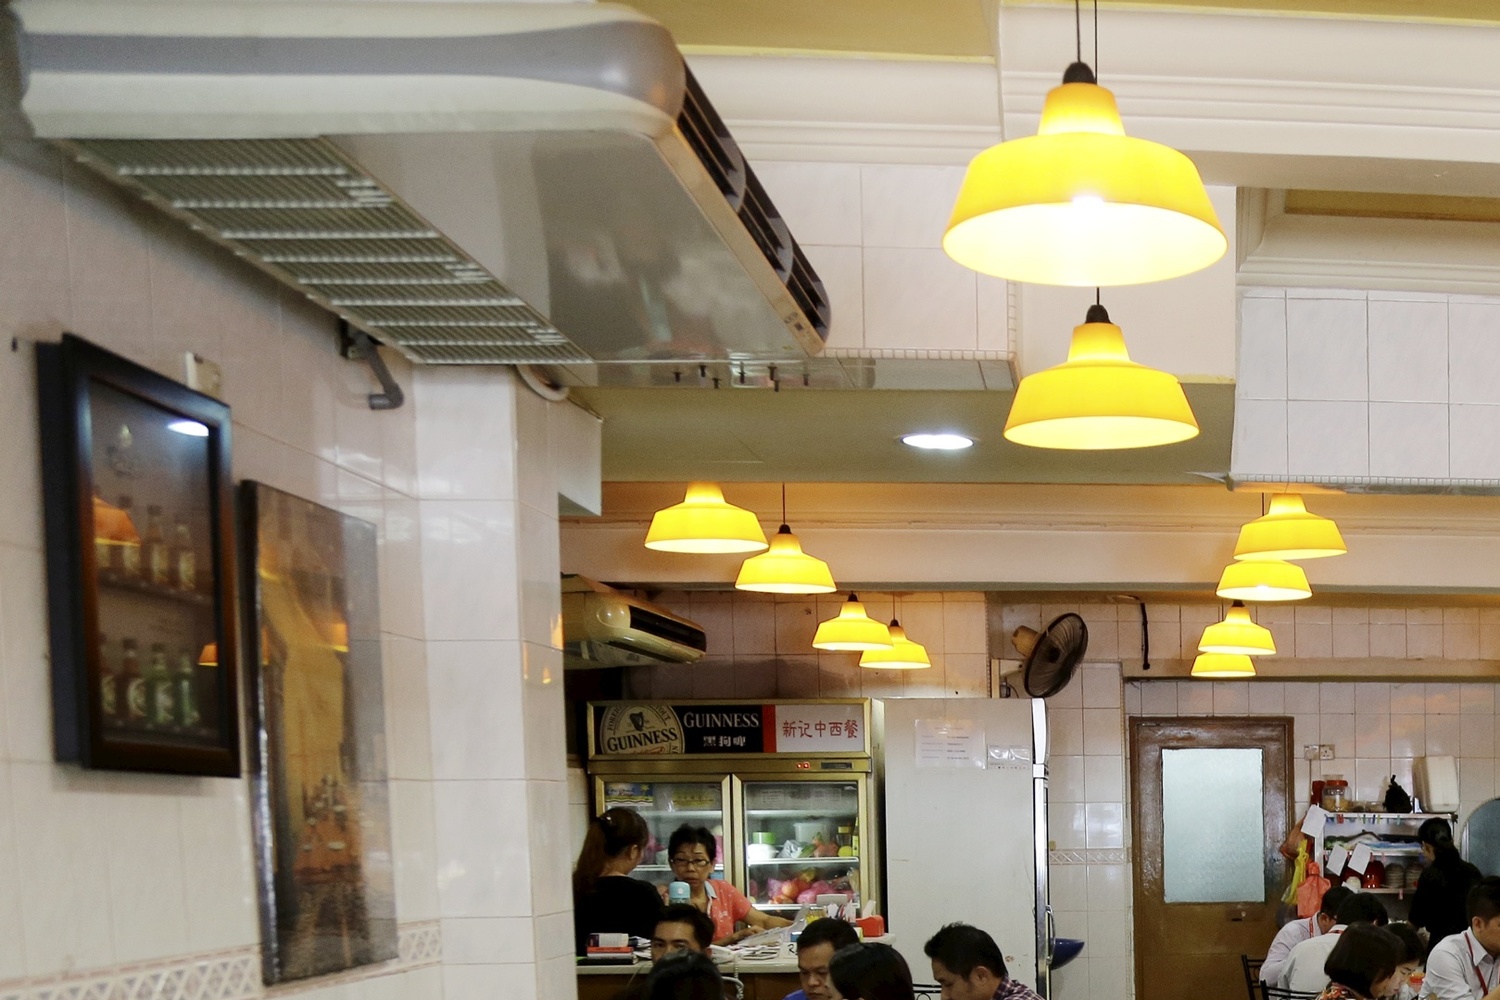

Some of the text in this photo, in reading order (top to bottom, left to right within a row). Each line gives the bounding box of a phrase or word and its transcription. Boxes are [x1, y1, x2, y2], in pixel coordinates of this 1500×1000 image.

[683, 711, 760, 728] GUINNESS
[782, 719, 859, 739] 新记中西餐
[606, 727, 679, 752] GUINNESS
